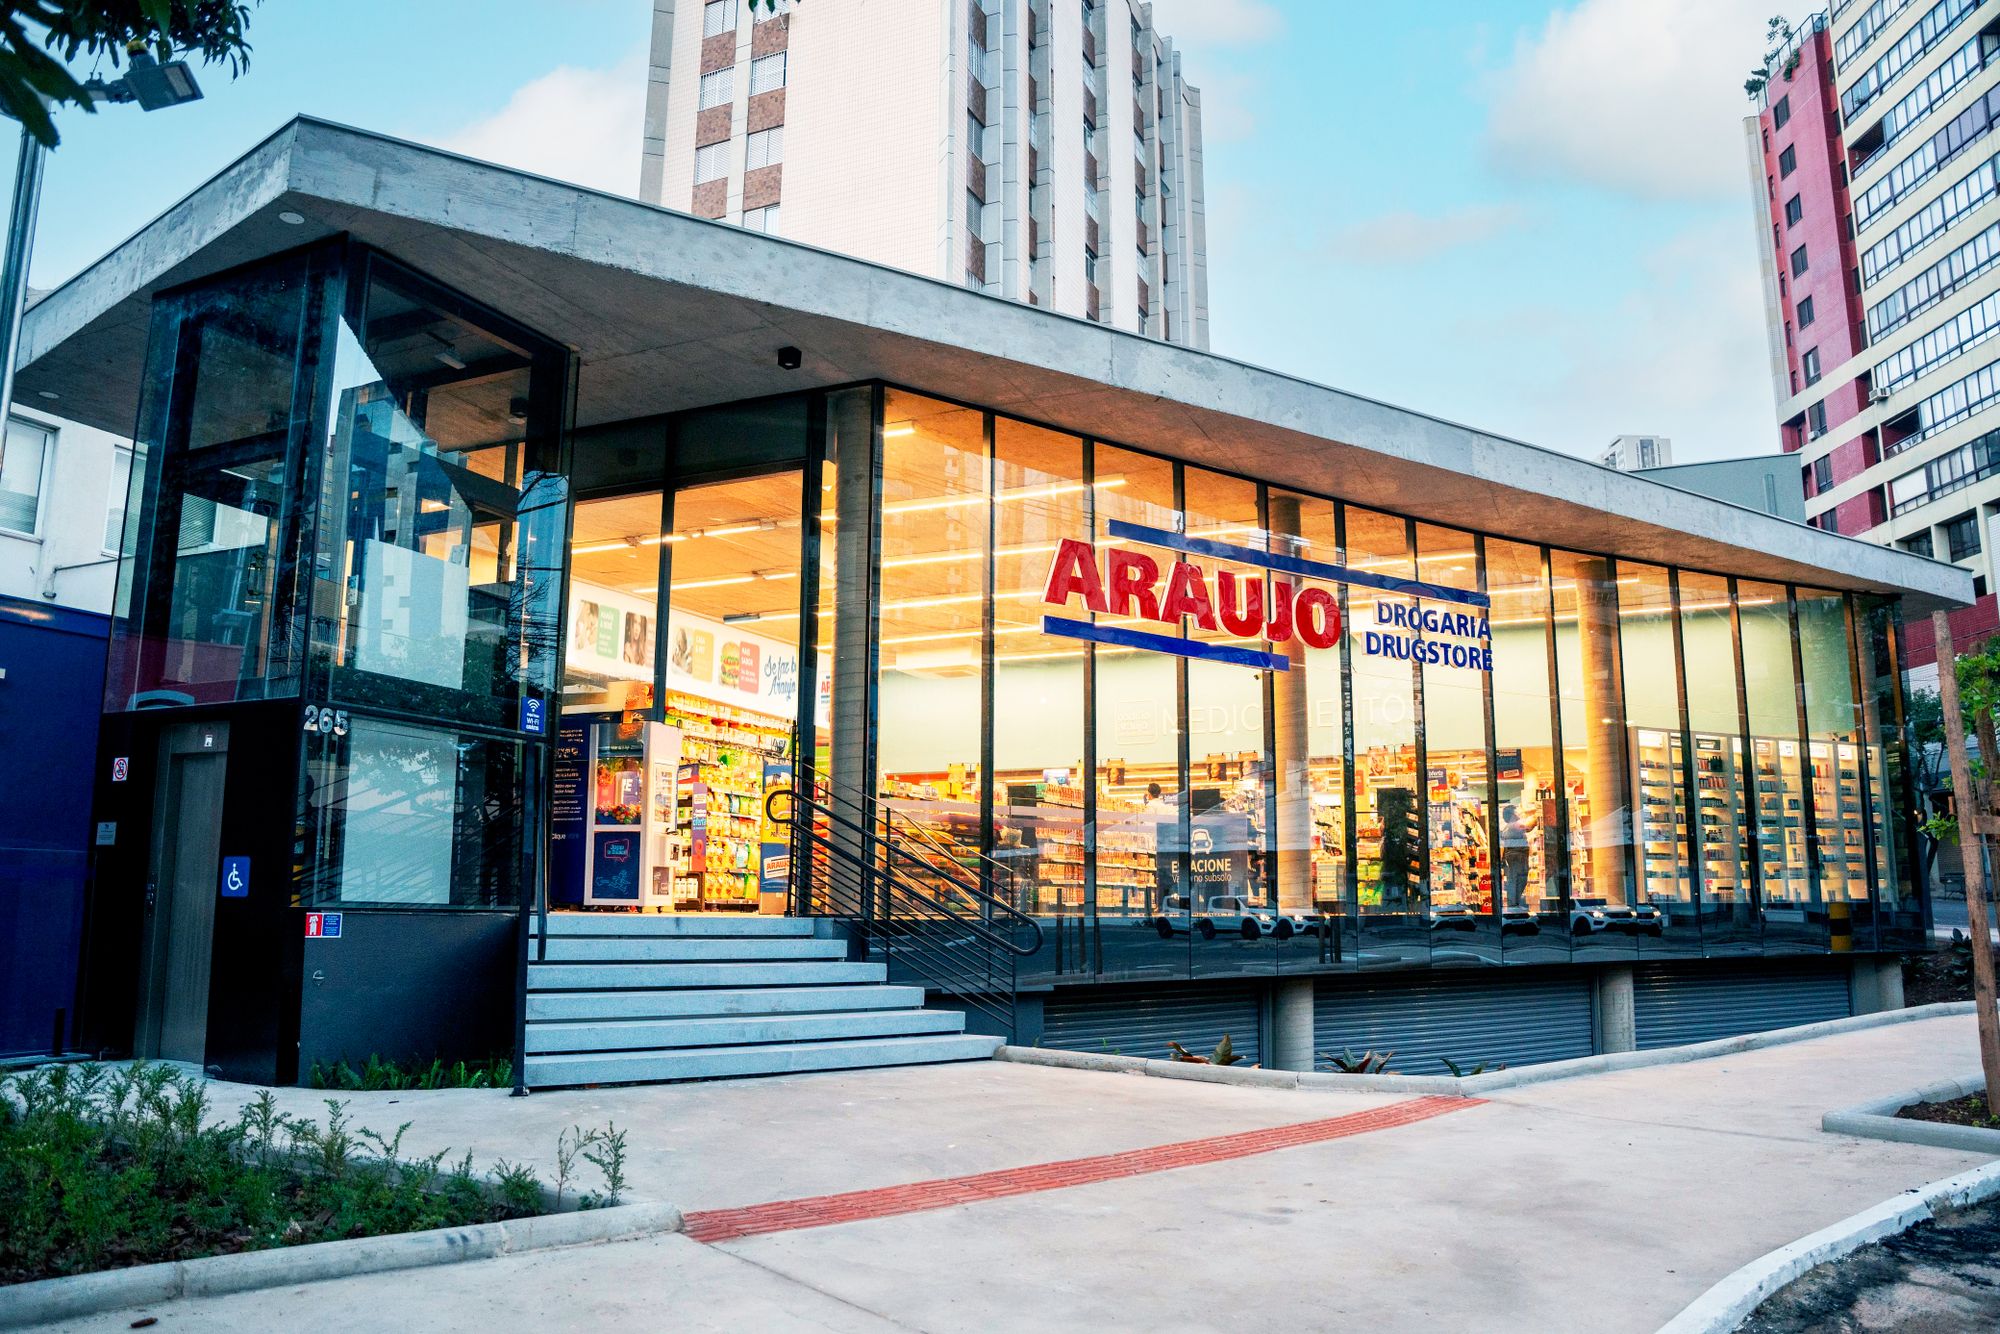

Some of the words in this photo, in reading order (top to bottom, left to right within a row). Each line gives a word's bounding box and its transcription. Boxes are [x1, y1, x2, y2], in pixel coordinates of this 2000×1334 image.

[1040, 537, 1342, 650] ARAUJO
[1372, 599, 1493, 642] DROGARIA
[1361, 631, 1494, 672] DRUGSTORE
[303, 704, 349, 736] 265
[1171, 858, 1232, 874] EACIONE
[1193, 875, 1203, 883] no
[1204, 873, 1232, 883] subsolo
